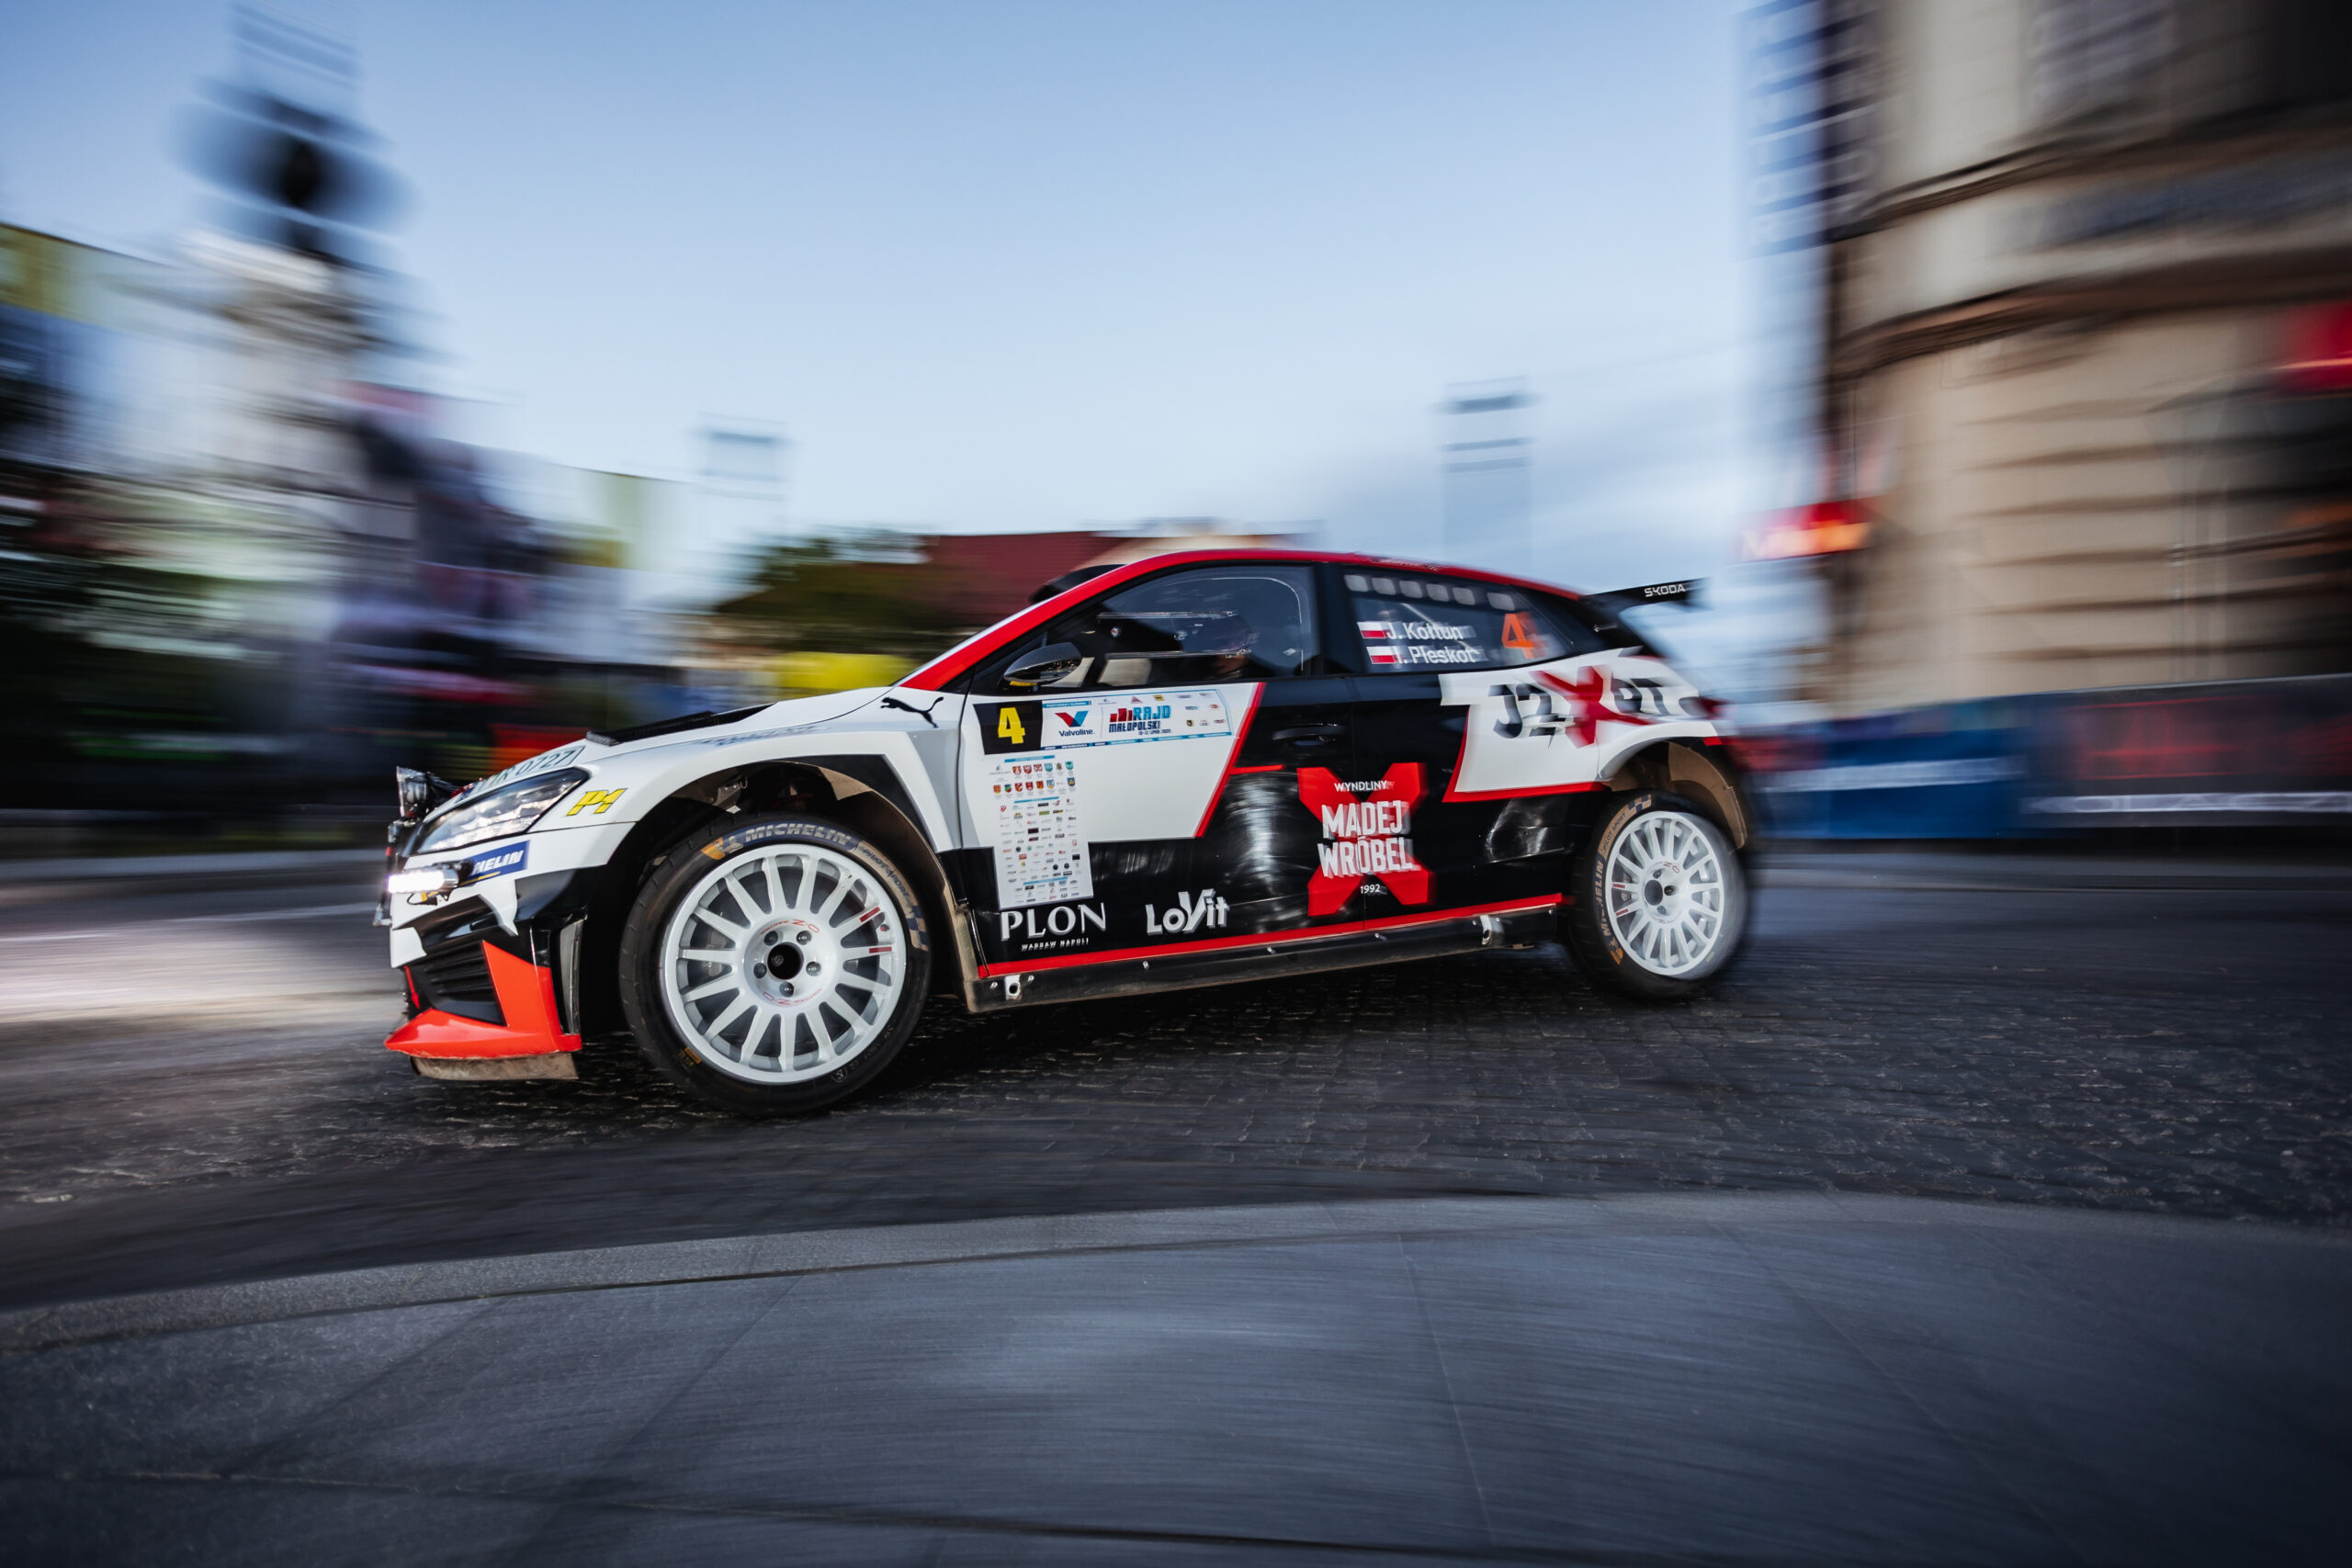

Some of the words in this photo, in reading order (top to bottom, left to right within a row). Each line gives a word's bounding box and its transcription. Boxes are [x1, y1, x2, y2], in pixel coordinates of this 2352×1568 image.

[1501, 613, 1535, 660] 4
[1408, 645, 1477, 665] Pleskot
[1133, 705, 1170, 721] RAJD
[998, 706, 1025, 744] 4
[1058, 729, 1093, 738] Valvoline
[1108, 720, 1161, 733] MAŁOPOLSKI
[1334, 780, 1389, 793] WYNDLINY
[1321, 799, 1407, 839] MADEJ
[745, 822, 853, 845] MICHELIN
[471, 850, 525, 876] HELIN
[1317, 835, 1415, 878] WRÓBEL
[1360, 883, 1381, 895] 1992
[1001, 902, 1106, 942] PLON
[1021, 940, 1057, 952] WARSAW
